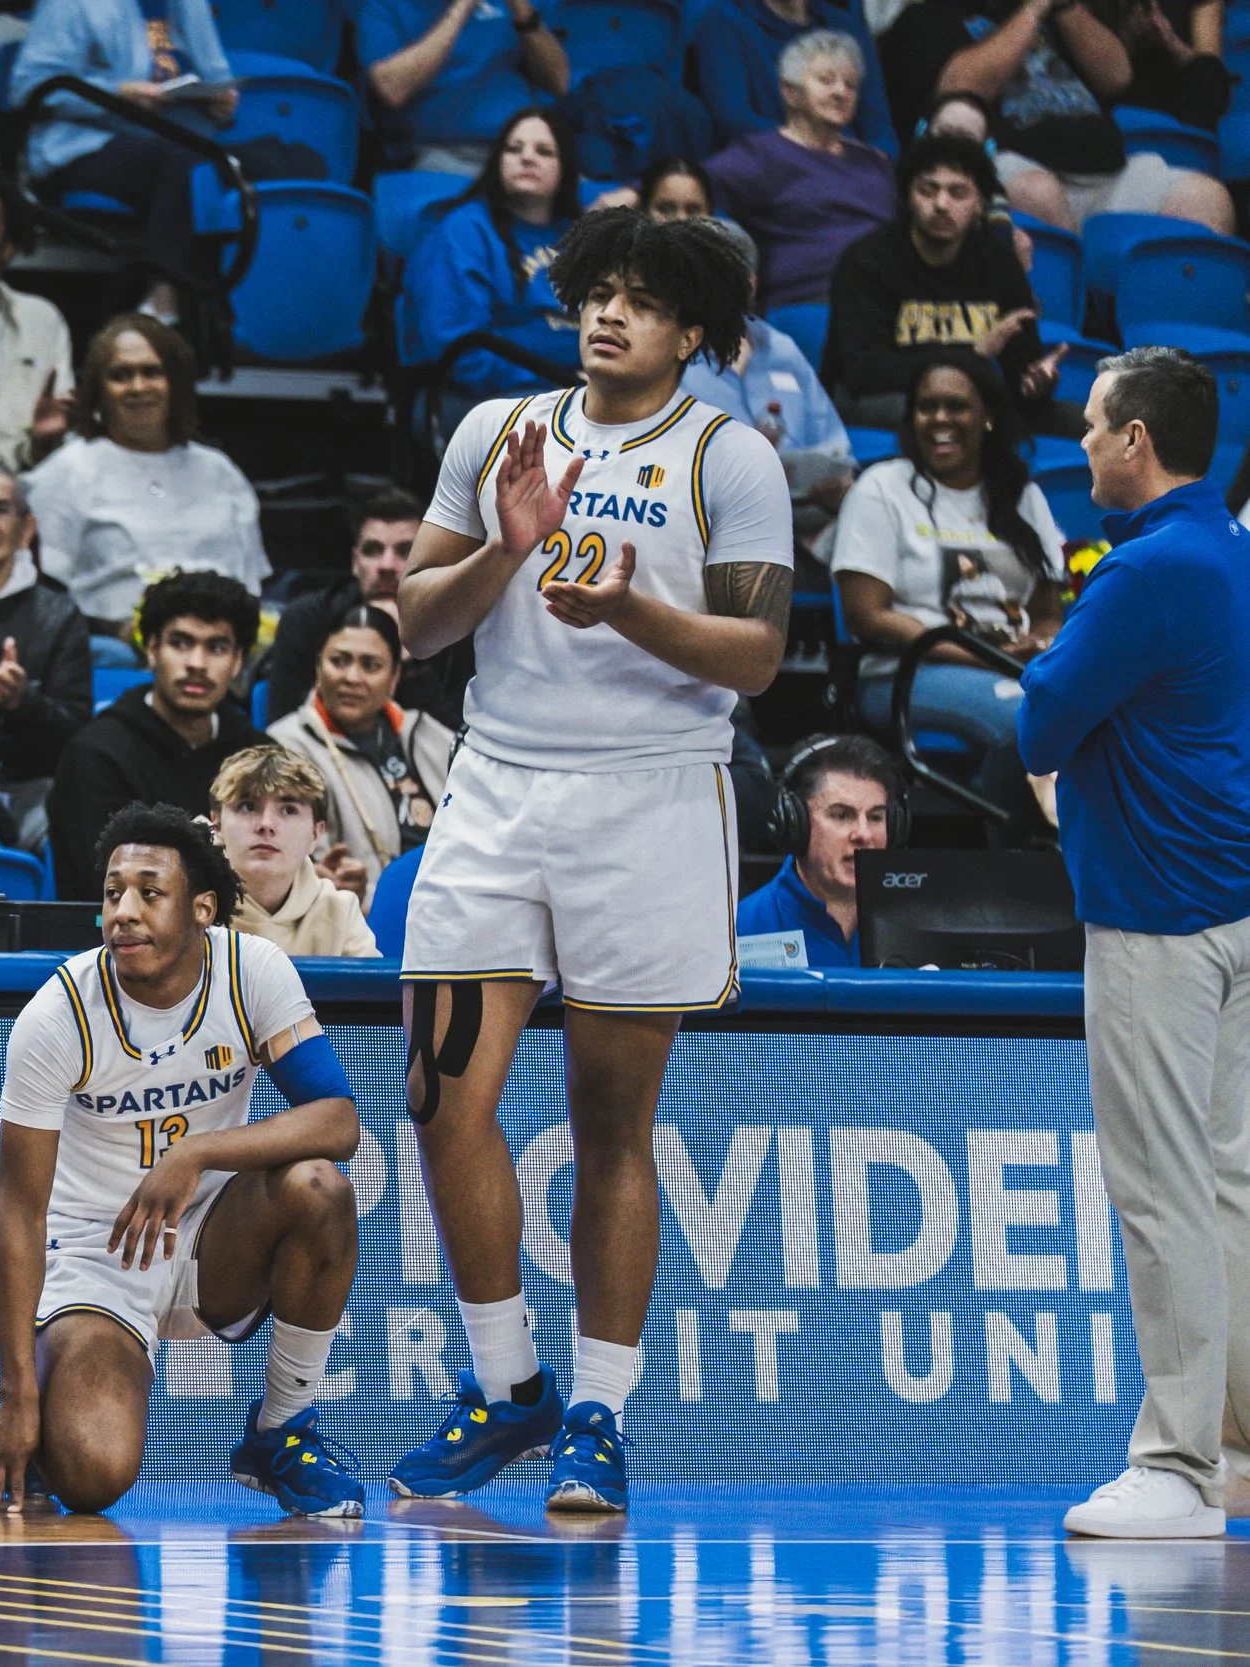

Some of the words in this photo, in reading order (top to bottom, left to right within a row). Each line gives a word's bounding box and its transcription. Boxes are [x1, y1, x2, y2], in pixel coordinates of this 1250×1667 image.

[568, 491, 668, 528] RTANS
[536, 528, 607, 592] 22
[882, 872, 928, 888] acer
[75, 1066, 247, 1115] SPARTANS
[135, 1113, 190, 1170] 13
[880, 1310, 1117, 1404] UNI
